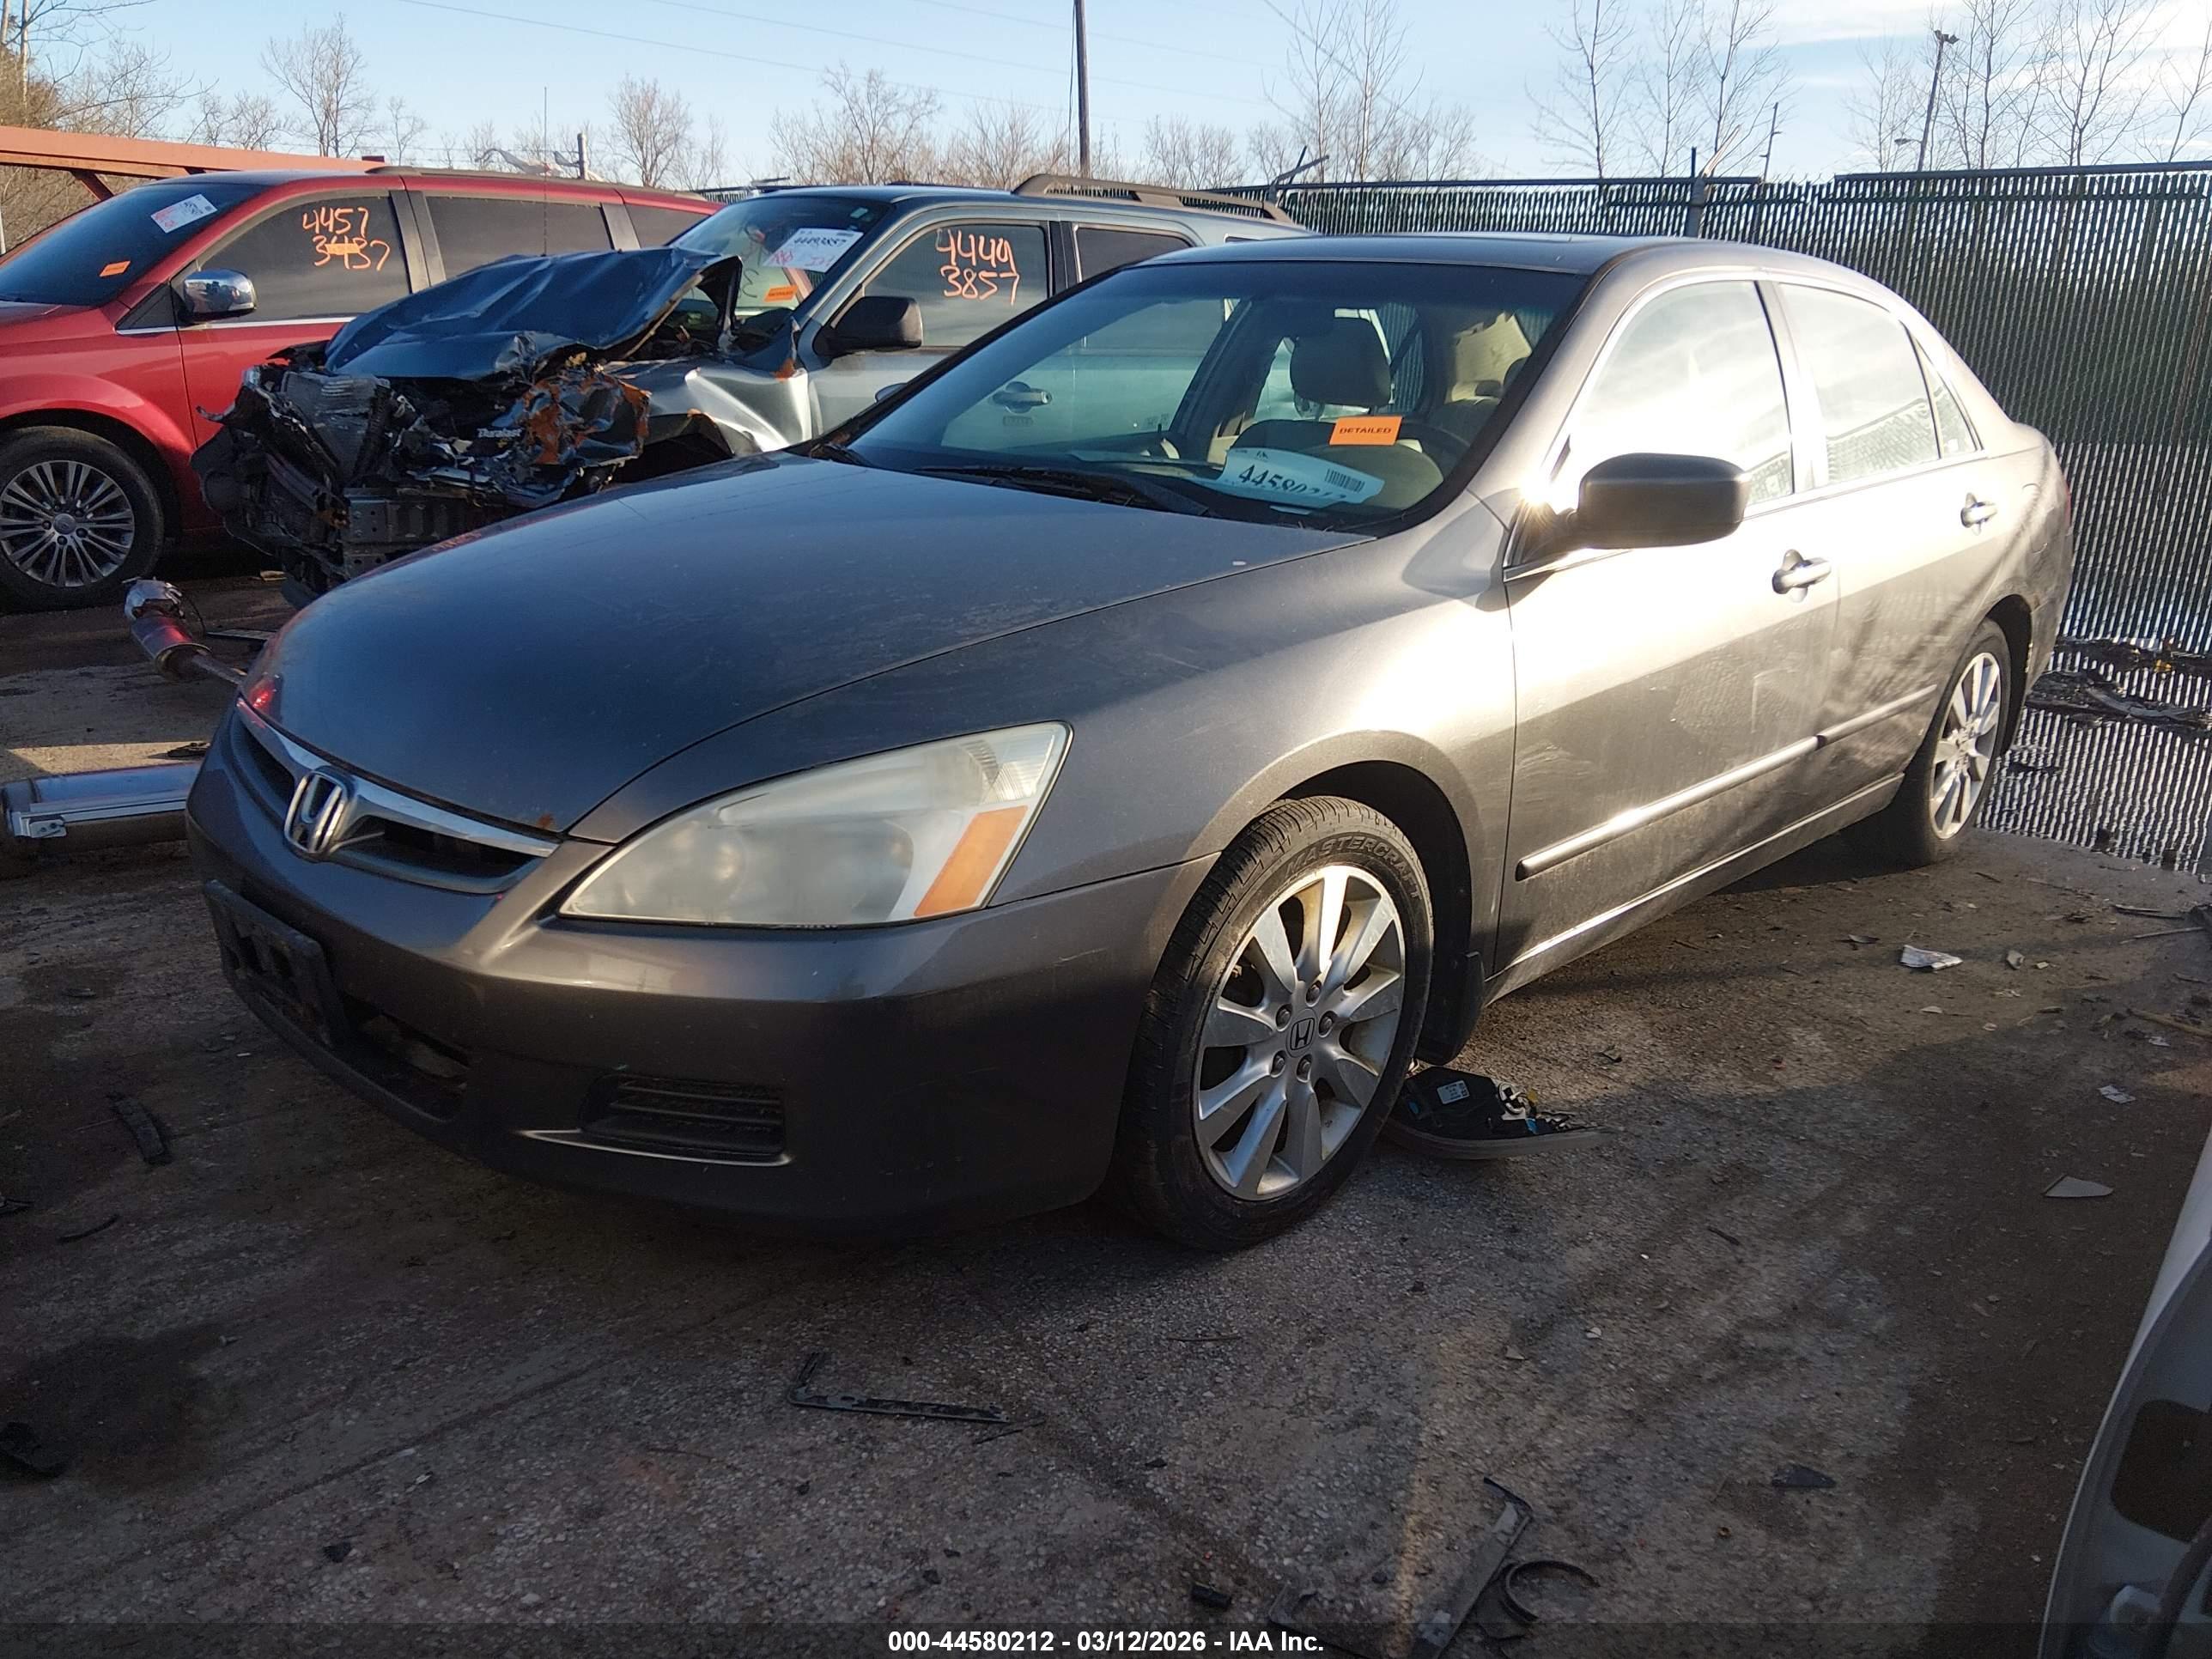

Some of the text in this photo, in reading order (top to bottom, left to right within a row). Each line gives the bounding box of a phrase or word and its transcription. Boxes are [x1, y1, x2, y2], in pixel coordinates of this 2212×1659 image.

[302, 207, 368, 239] 4457
[935, 228, 1018, 275] 4449
[940, 266, 1020, 306] 3857
[1285, 836, 1422, 902] MASTERCRAFT
